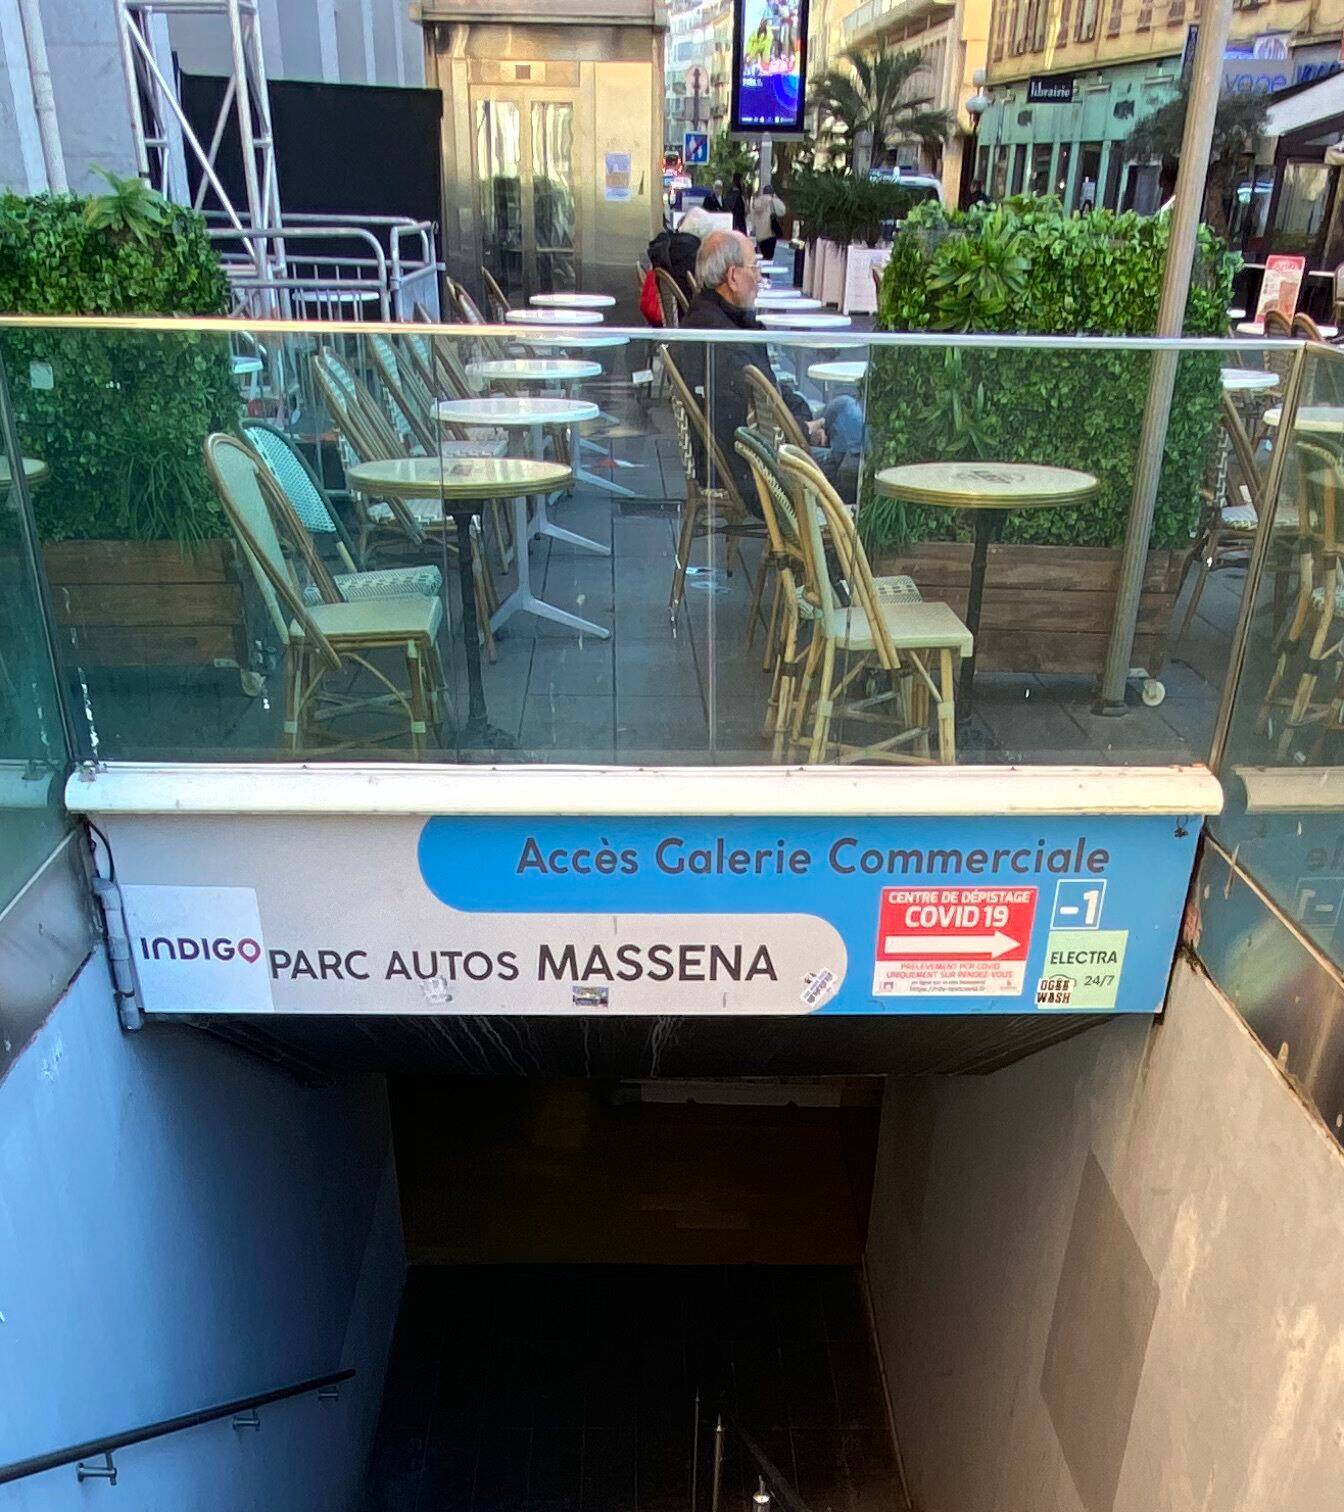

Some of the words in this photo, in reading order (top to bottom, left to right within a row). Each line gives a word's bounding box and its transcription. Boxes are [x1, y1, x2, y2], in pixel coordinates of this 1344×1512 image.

[1030, 81, 1070, 97] librairie
[515, 836, 639, 875] Accès
[655, 837, 811, 875] Galerie
[829, 837, 1110, 875] Commerciale
[889, 891, 938, 904] CENTRE
[941, 891, 958, 904] DE
[961, 889, 1030, 904] DÉPISTAGE
[905, 905, 980, 928] COVID
[983, 905, 1009, 928] 19
[1059, 889, 1099, 925] -1
[141, 937, 261, 963] INDIGO
[1050, 951, 1117, 965] ELECTRA
[269, 949, 368, 981] PARC
[385, 950, 519, 981] AUTOS
[537, 943, 778, 982] MASSENA
[1084, 975, 1115, 987] 24/7
[1037, 992, 1071, 1004] WASH
